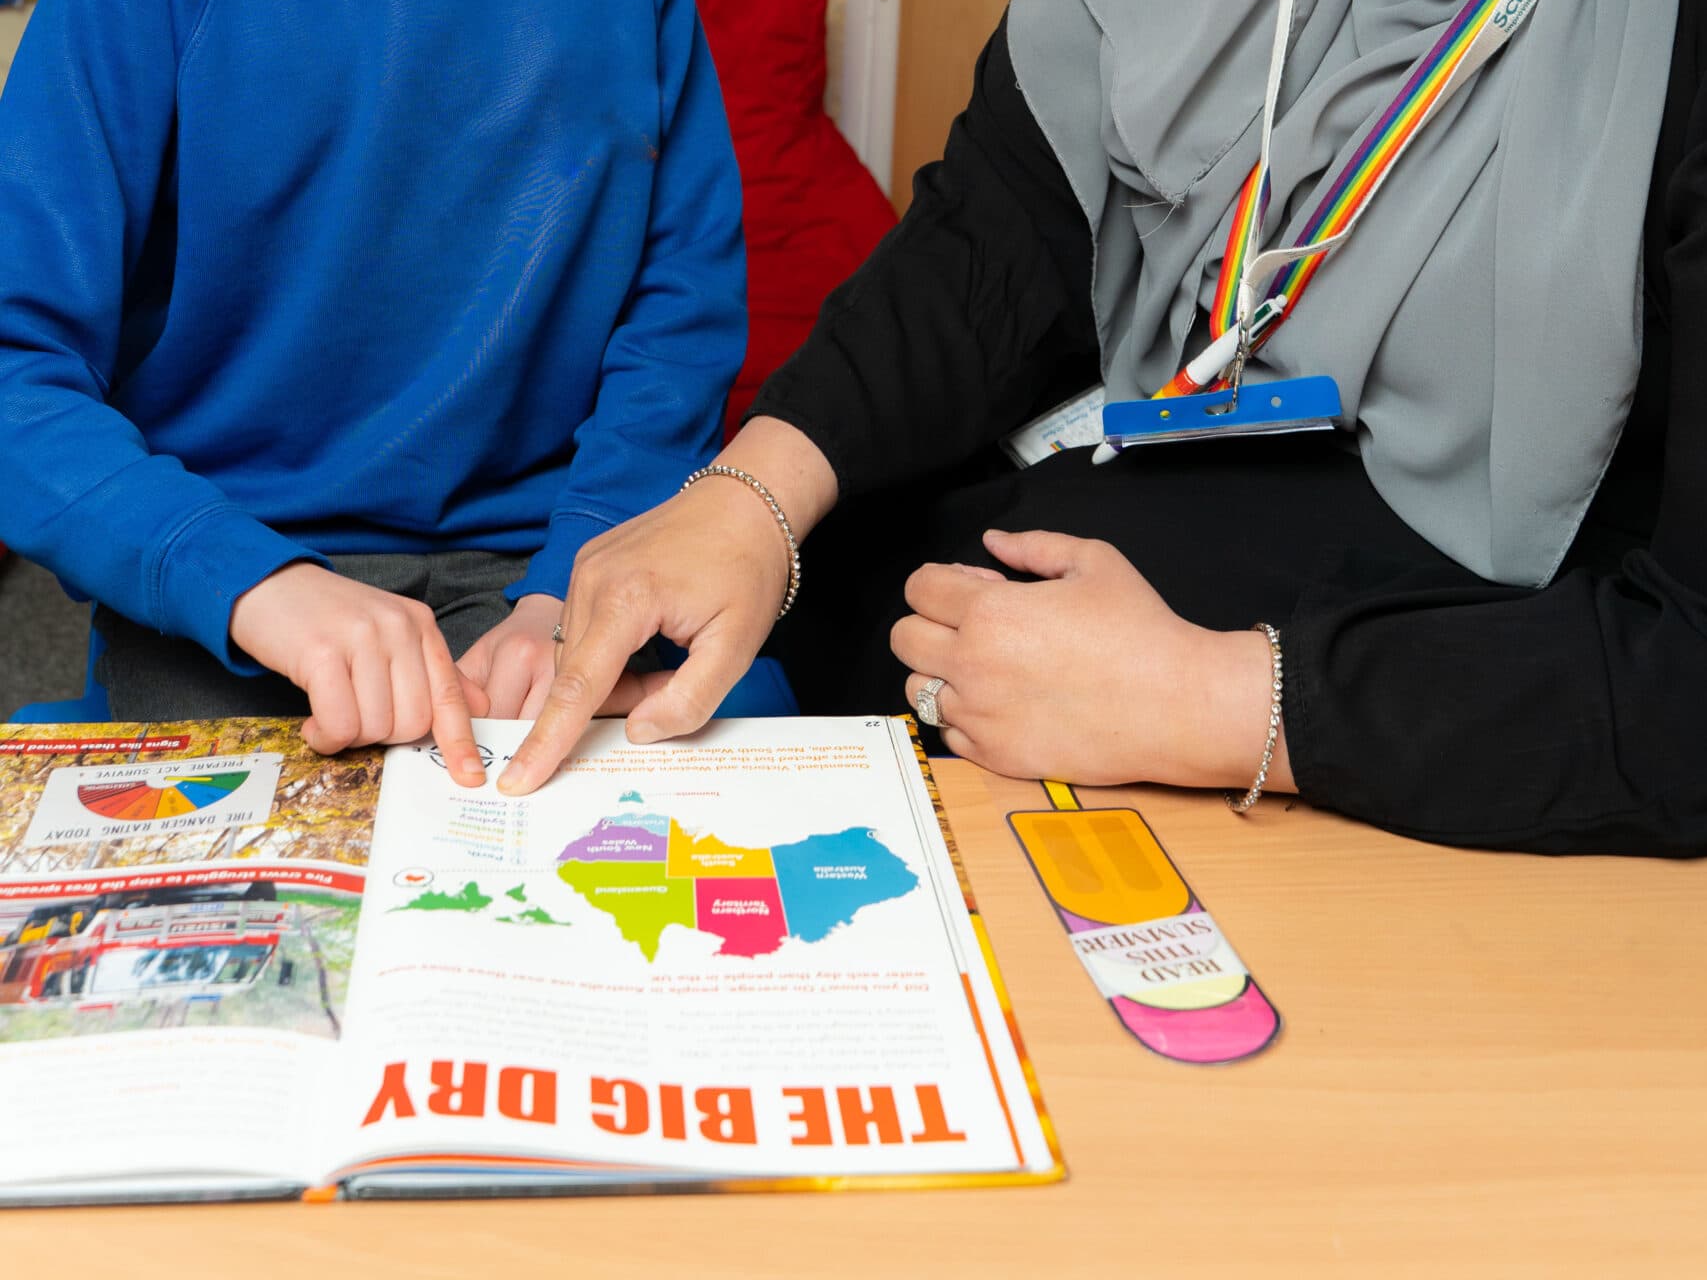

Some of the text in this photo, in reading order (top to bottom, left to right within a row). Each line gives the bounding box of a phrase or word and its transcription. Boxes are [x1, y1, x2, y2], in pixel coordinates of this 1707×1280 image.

[864, 720, 880, 728] 22
[26, 743, 77, 752] warned
[119, 742, 142, 750] like
[146, 740, 180, 748] Signs
[810, 744, 864, 752] Australia,
[678, 756, 726, 764] drought
[834, 754, 867, 762] worst
[190, 760, 244, 770] PREPARE
[600, 766, 654, 774] Australia
[794, 762, 870, 772] Queensland,
[96, 768, 150, 778] SURVIVE
[448, 797, 507, 807] Canberra
[44, 811, 253, 840] FIRE DANGER RATING TODAY
[587, 844, 652, 853] New South
[260, 870, 302, 879] crews
[814, 866, 866, 874] Australia
[128, 876, 162, 886] stop
[166, 876, 182, 885] to
[186, 870, 256, 885] struggled
[304, 872, 332, 884] Fire
[816, 872, 868, 880] Western
[64, 883, 96, 893] fires
[100, 880, 125, 890] the
[594, 886, 668, 894] Queensland
[712, 899, 768, 908] Territory
[712, 906, 770, 915] Northern
[1074, 919, 1212, 954] SUMMER!
[1126, 942, 1200, 965] THIS
[1140, 958, 1222, 984] READ
[580, 982, 644, 994] Australia
[361, 1060, 557, 1127] DRY
[590, 1076, 757, 1146] BIG
[782, 1084, 966, 1145] THE
